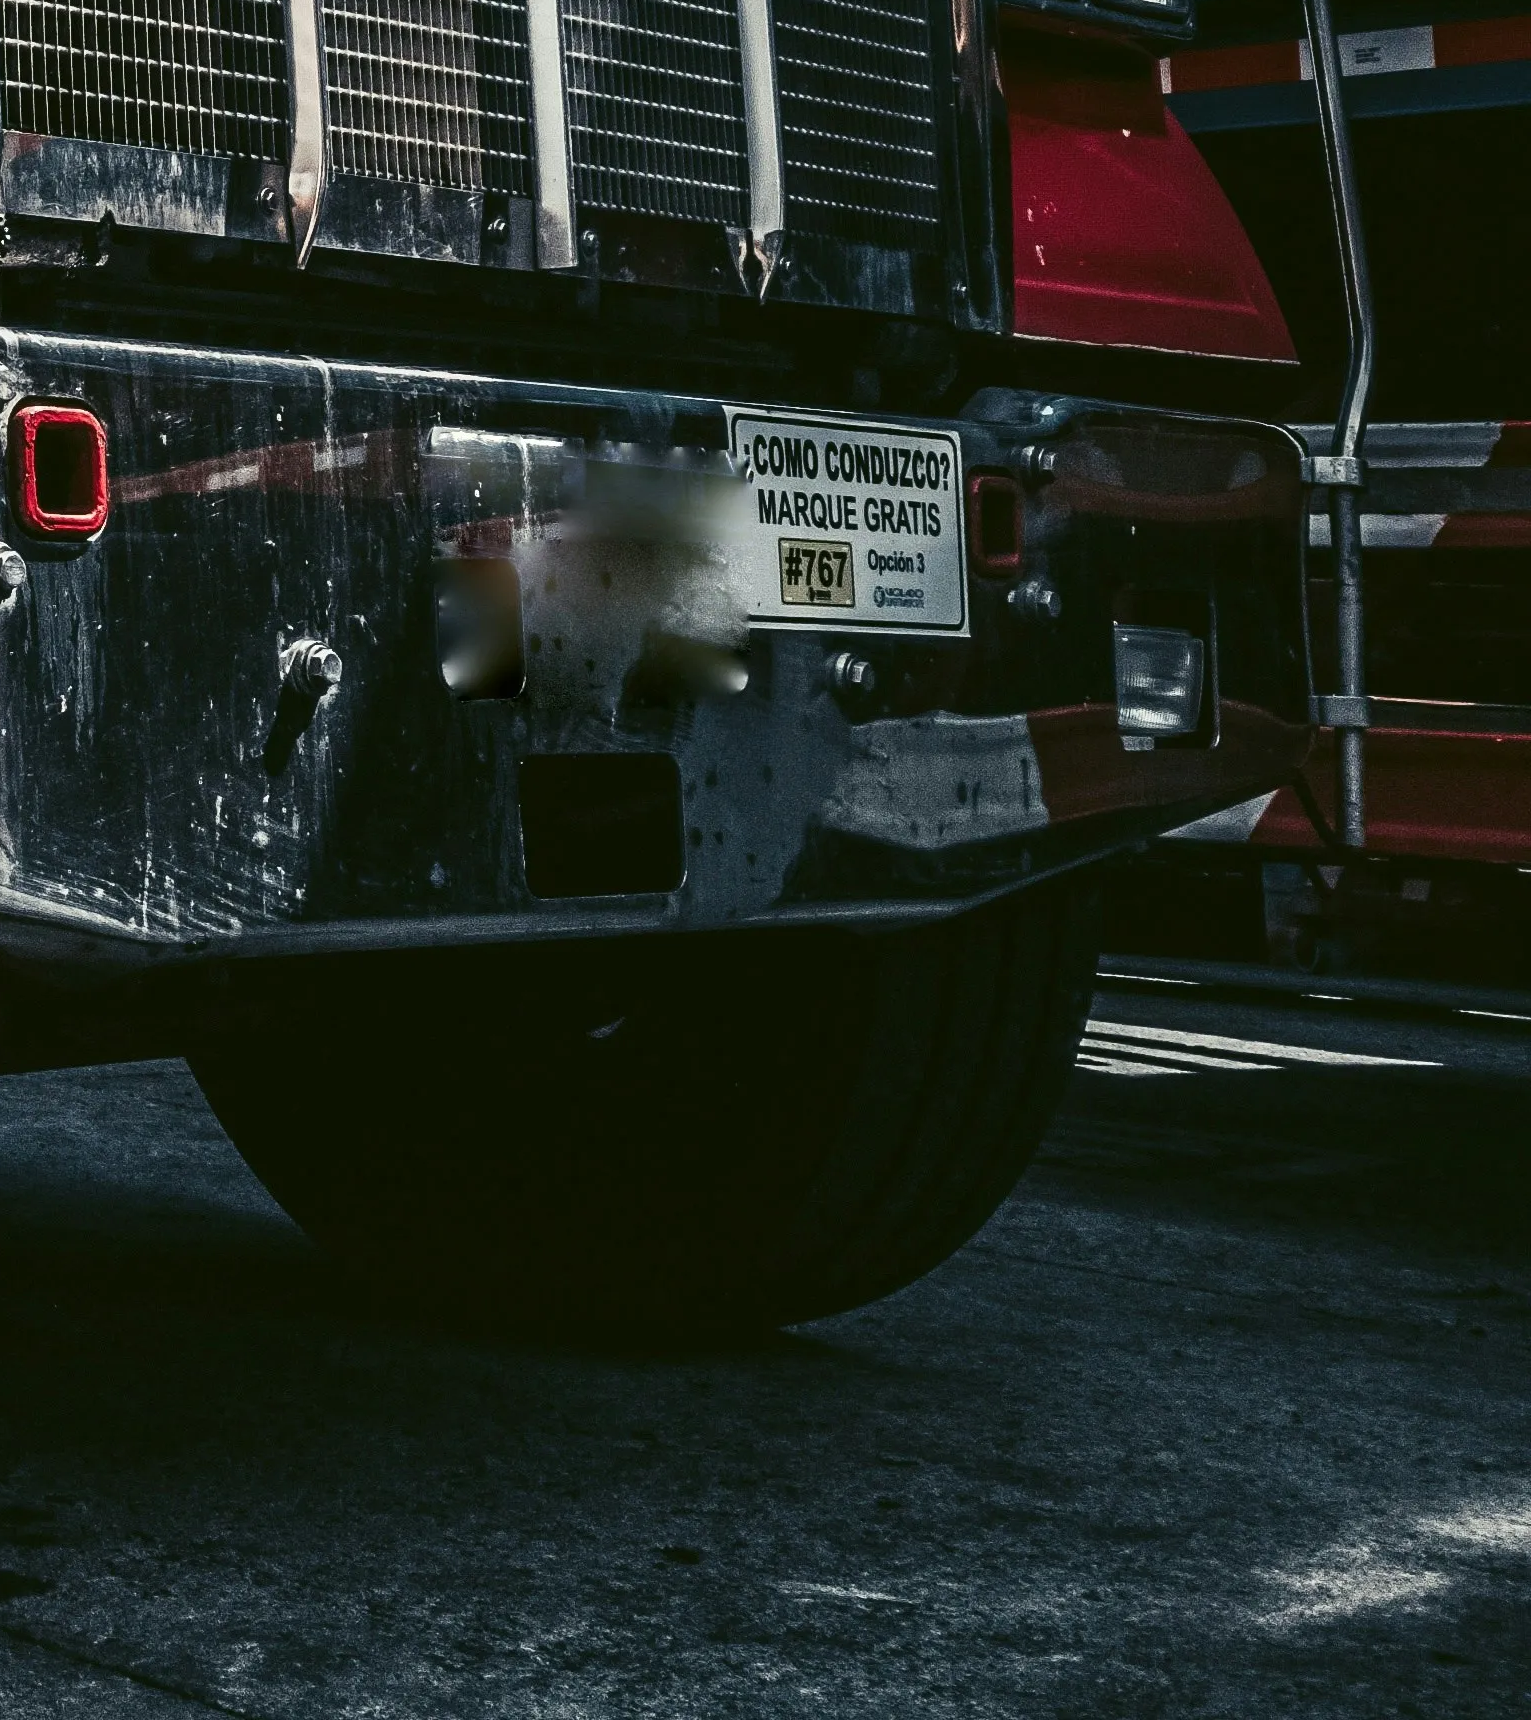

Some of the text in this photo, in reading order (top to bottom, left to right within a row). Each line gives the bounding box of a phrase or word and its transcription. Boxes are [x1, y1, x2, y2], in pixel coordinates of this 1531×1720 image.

[825, 440, 951, 491] CONDUZCO?
[757, 488, 941, 537] MARQUE GRATIS
[785, 547, 848, 588] #767
[916, 551, 925, 574] 3
